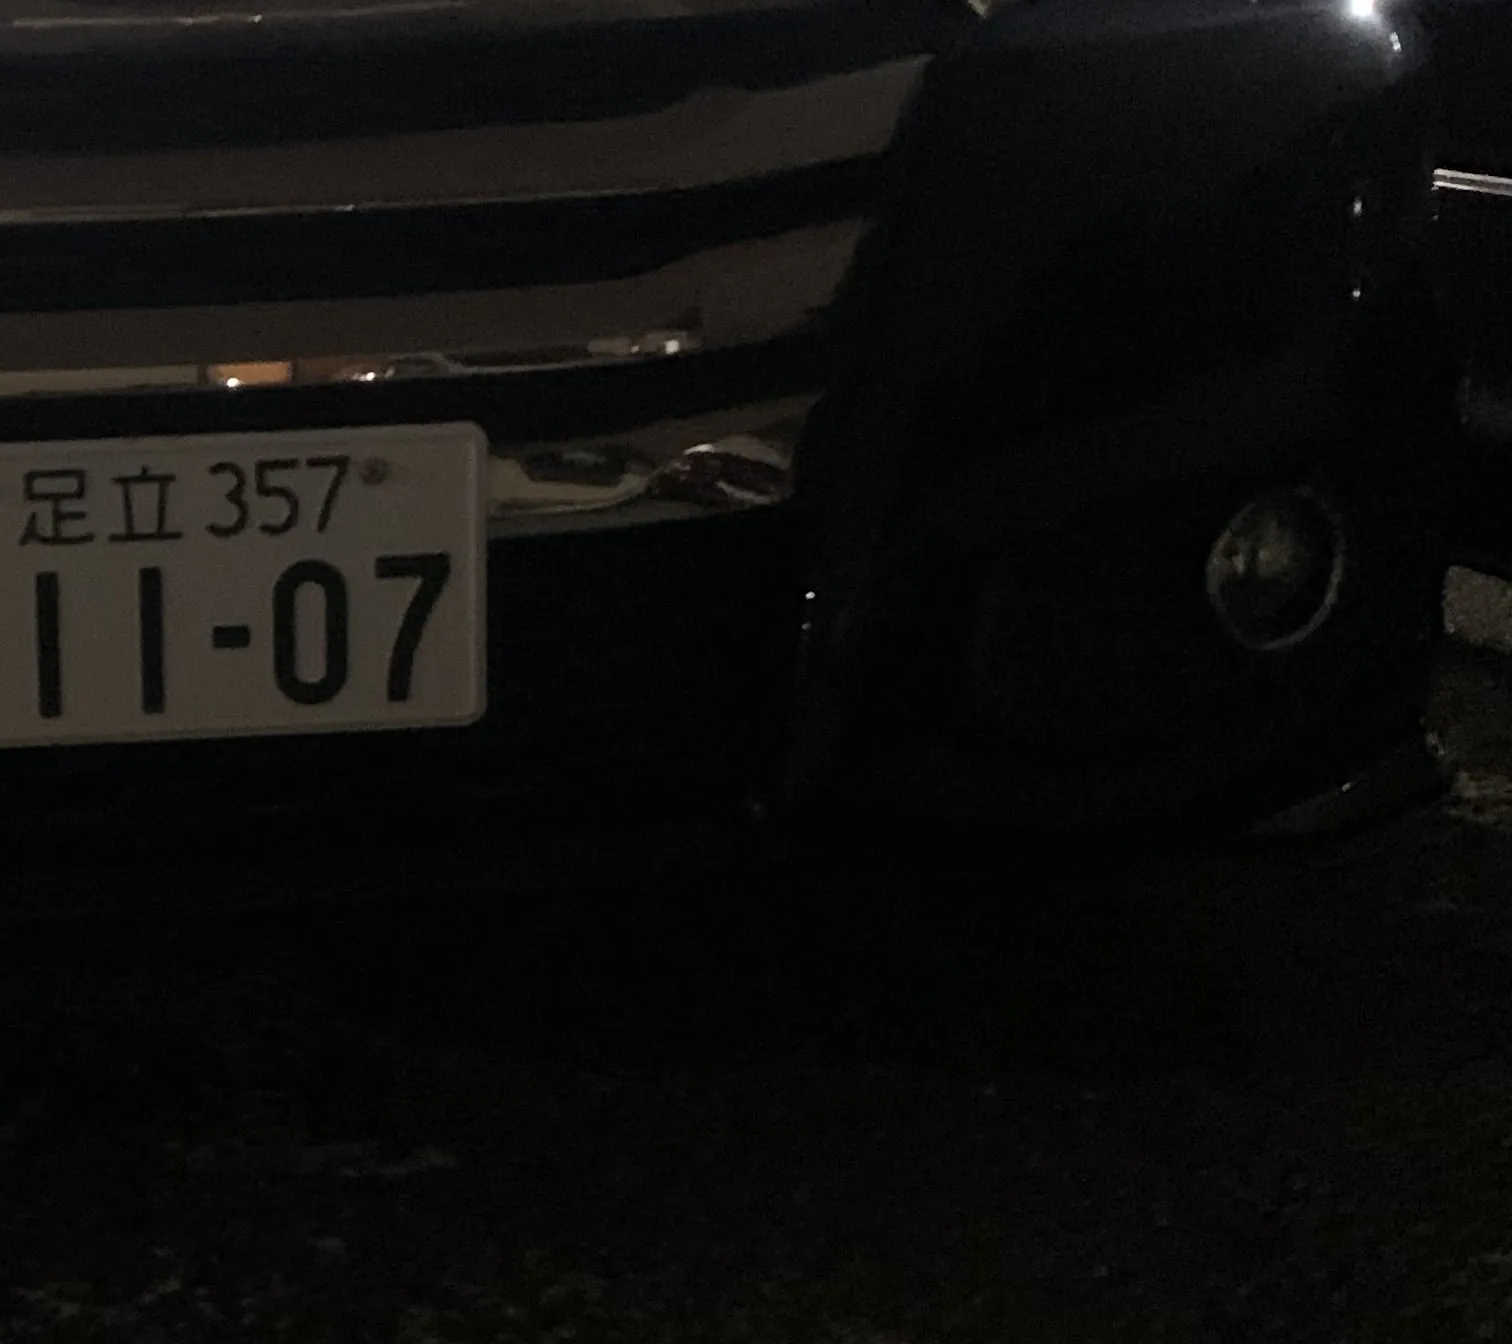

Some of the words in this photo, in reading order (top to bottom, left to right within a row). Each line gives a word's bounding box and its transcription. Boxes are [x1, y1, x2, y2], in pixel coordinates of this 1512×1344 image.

[19, 465, 183, 545] 足立
[205, 455, 350, 538] 357
[35, 553, 452, 718] 11-07
